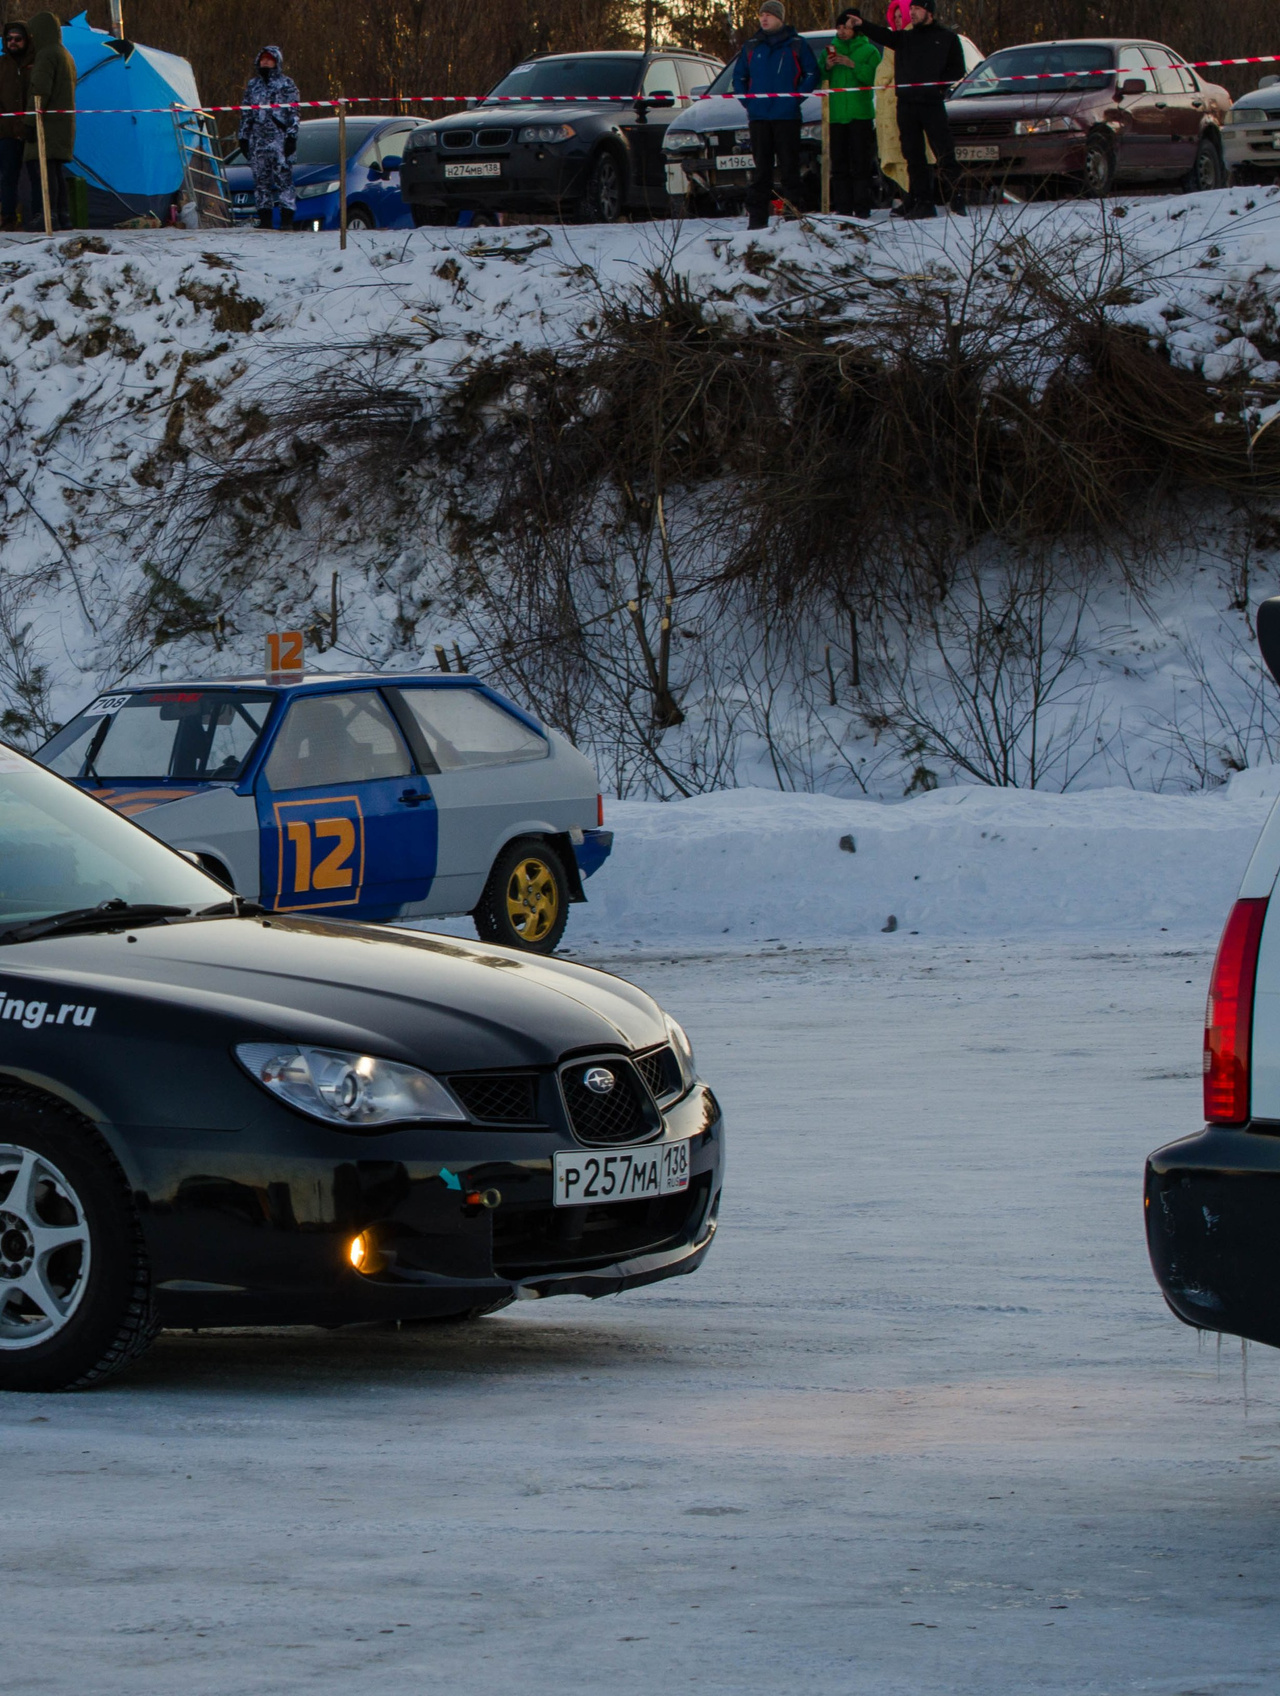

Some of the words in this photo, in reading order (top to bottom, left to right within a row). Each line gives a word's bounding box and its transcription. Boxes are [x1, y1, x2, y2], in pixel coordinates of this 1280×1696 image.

[956, 148, 983, 158] 99ТС
[720, 157, 754, 167] М196С
[447, 165, 482, 176] Н274МВ
[483, 163, 498, 171] 138
[267, 631, 303, 671] 12
[93, 697, 127, 710] 708
[287, 817, 355, 893] 12
[565, 1155, 658, 1199] Р257МА
[664, 1144, 687, 1177] 138
[666, 1177, 680, 1188] RUS
